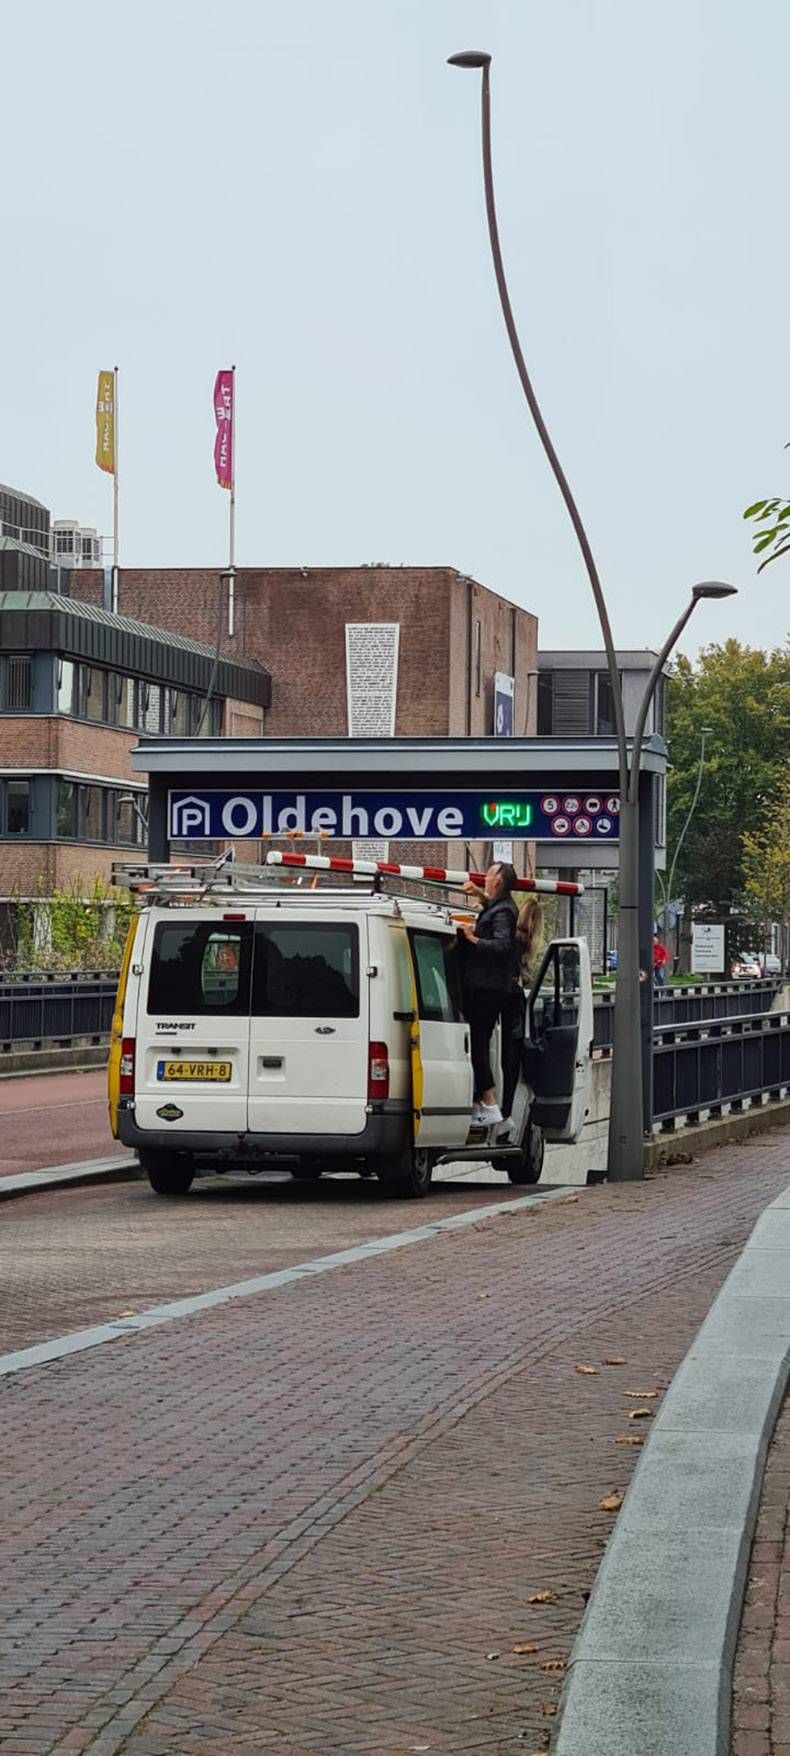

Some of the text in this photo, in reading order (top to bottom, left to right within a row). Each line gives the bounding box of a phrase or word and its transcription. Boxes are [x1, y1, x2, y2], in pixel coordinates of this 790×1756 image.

[547, 800, 554, 810] 5
[222, 796, 464, 836] Oldehove
[483, 802, 531, 827] VRIJ
[155, 1022, 196, 1030] TRANSIT
[167, 1064, 227, 1076] 64-VRH-8
